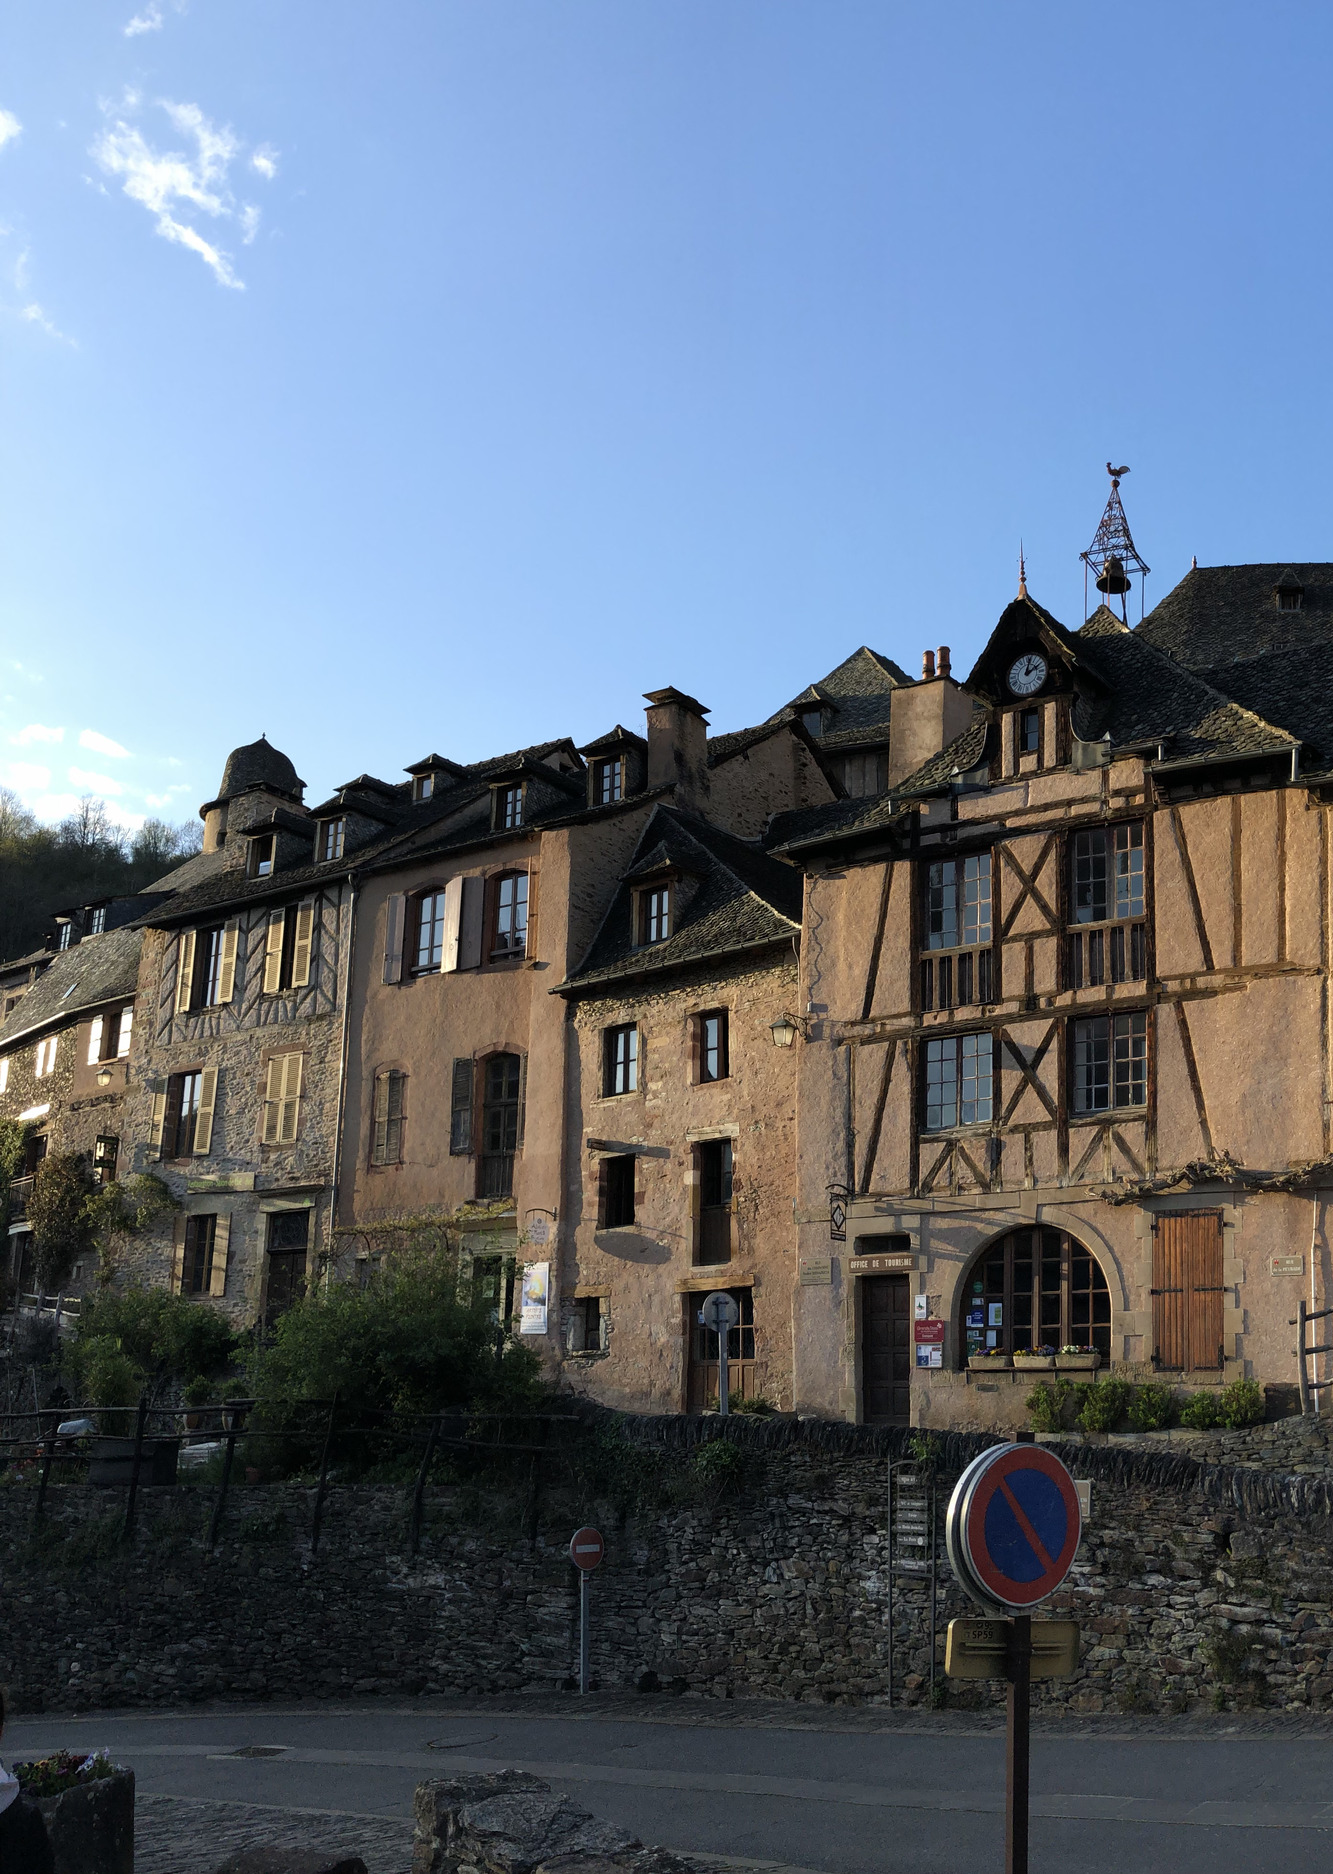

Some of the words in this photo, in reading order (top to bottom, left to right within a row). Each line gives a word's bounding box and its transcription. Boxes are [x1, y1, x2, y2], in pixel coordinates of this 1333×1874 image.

[850, 1260, 868, 1269] OFFICE
[872, 1260, 880, 1268] DE
[885, 1258, 912, 1267] TOURISME
